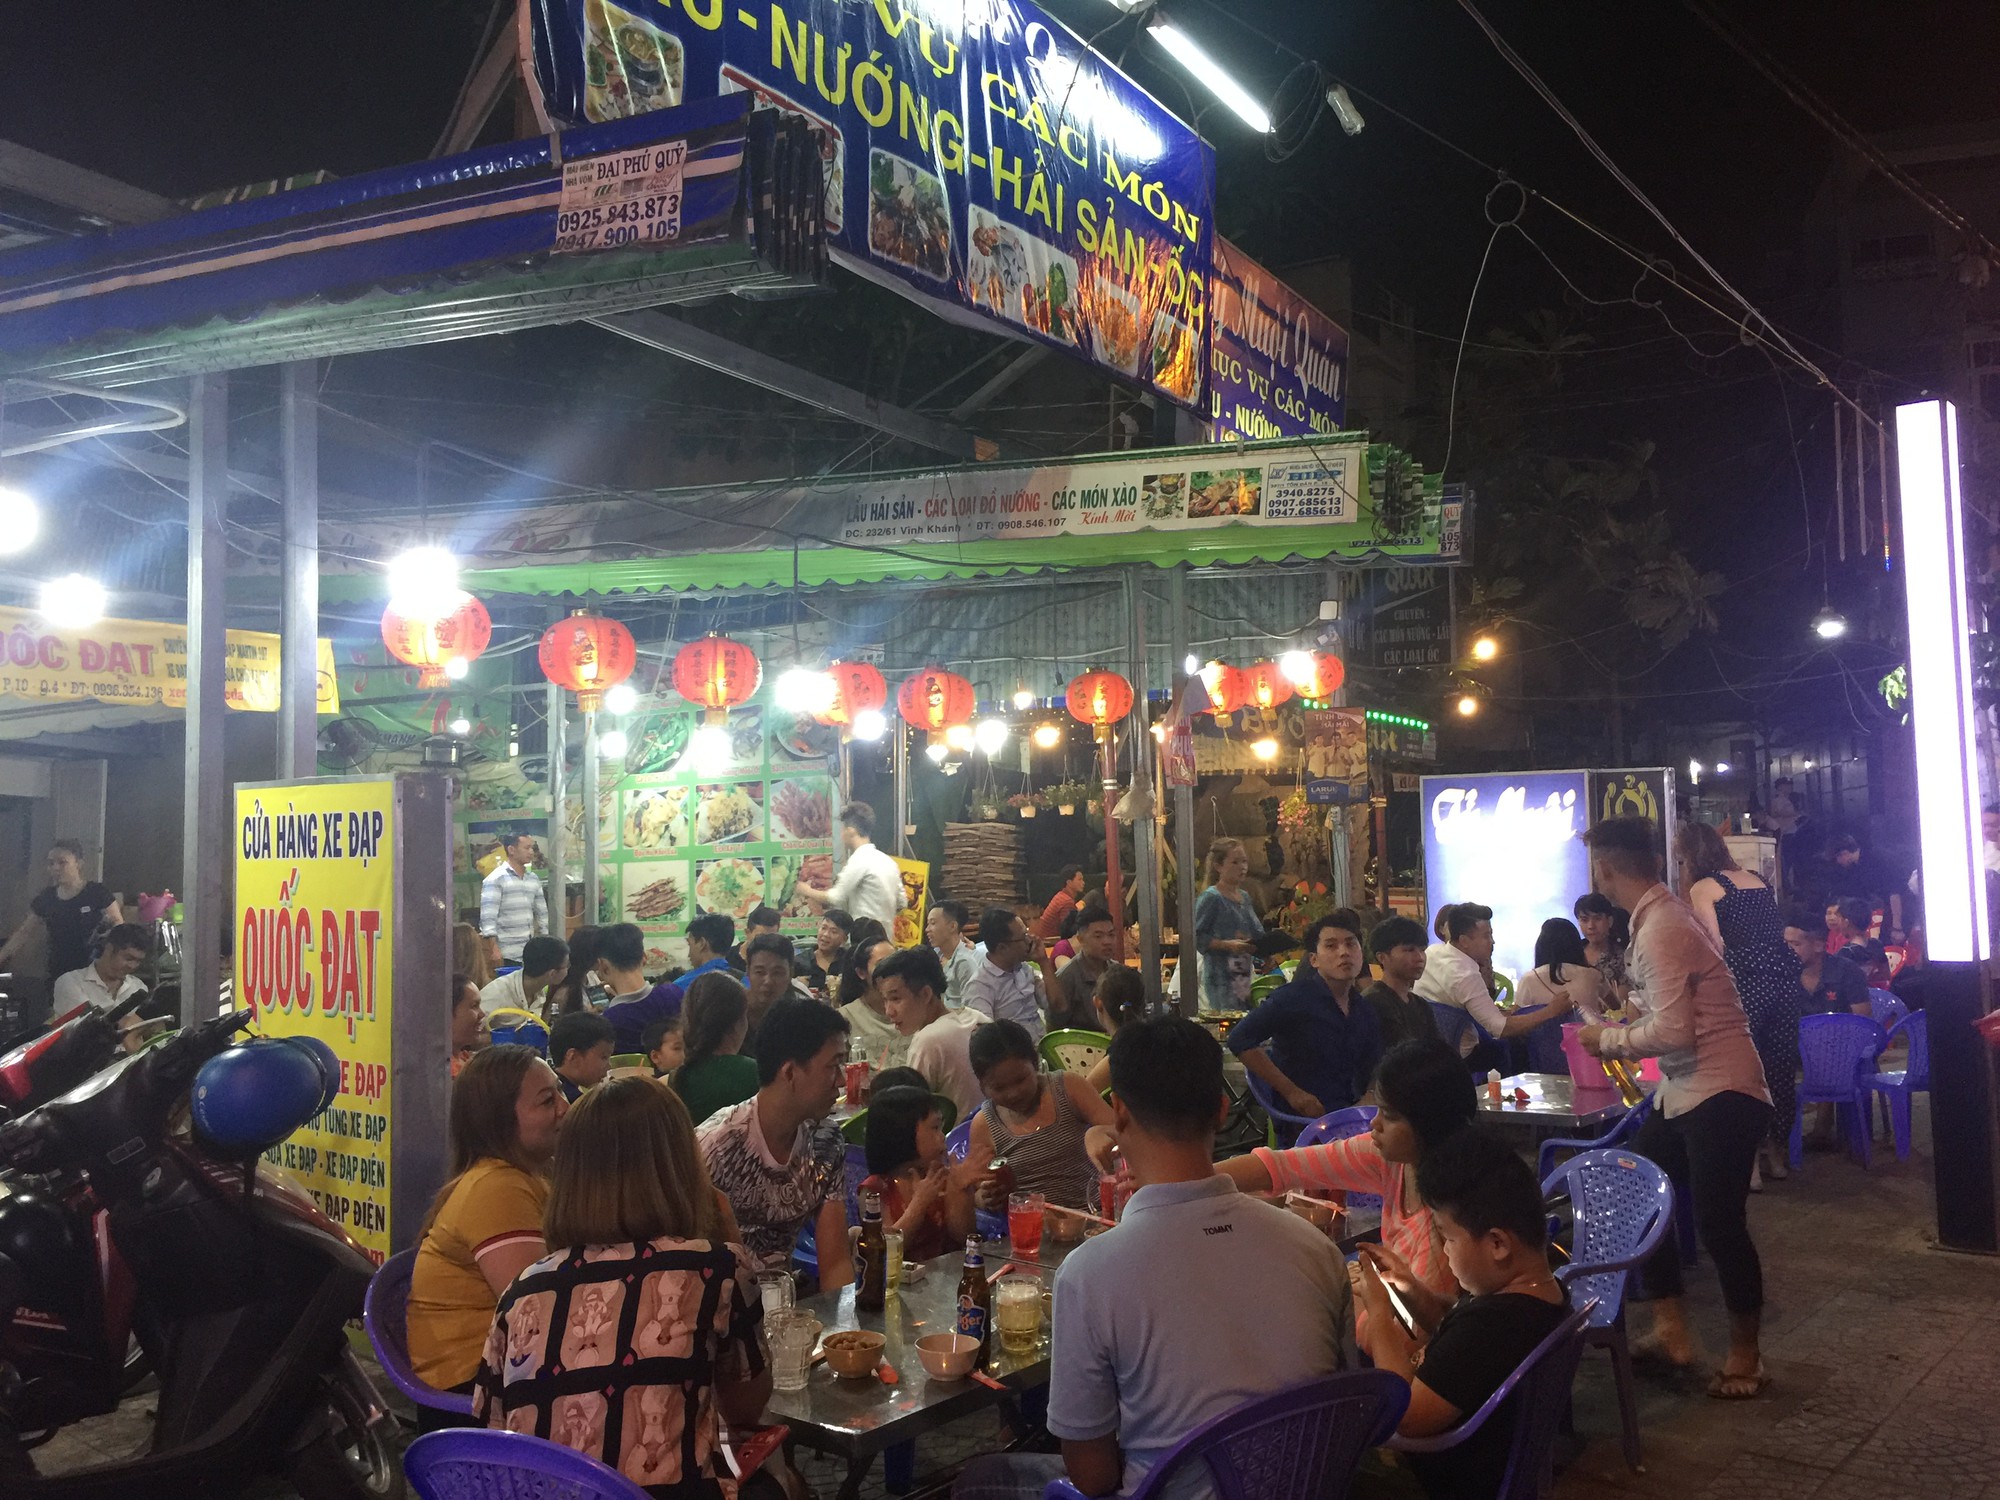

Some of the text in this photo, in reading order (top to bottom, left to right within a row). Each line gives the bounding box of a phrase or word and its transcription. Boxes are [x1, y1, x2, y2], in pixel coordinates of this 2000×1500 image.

[597, 159, 620, 182] ĐẠI
[622, 149, 651, 175] PHÚ
[654, 143, 684, 174] QUÝ
[558, 194, 679, 234] 0925.843.873
[1103, 152, 1200, 243] MÓN
[555, 218, 678, 250] 0947.900.105
[1212, 348, 1242, 385] ỤC
[1274, 388, 1306, 423] CÁC
[870, 495, 889, 521] HẢI
[892, 494, 915, 520] SẢN
[925, 492, 948, 518] CÁC
[951, 495, 976, 519] LOẠI
[979, 487, 997, 515] ĐỒ
[1000, 489, 1041, 514] NƯỚNG
[1052, 486, 1077, 511] CÁC
[1080, 483, 1109, 509] MÓN
[1111, 482, 1138, 507] XÀO
[1267, 506, 1341, 518] 0947.685613
[1268, 497, 1341, 508] 0907.685613
[1276, 487, 1335, 498] 3940.8275
[846, 529, 863, 538] ĐC:
[866, 526, 897, 537] 232/61
[927, 523, 961, 534] Khánh
[977, 521, 994, 531] ĐT:
[998, 517, 1067, 530] 0908.546.107
[79, 638, 156, 682] ĐẠT
[242, 799, 383, 868] CỬA HÀNG XE ĐẠP
[242, 867, 382, 1037] QUỐC ĐẠT
[339, 1060, 387, 1105] E ĐẠP
[350, 1111, 362, 1139] XE
[365, 1113, 387, 1147] ĐẠP
[285, 1143, 296, 1170] XE
[298, 1146, 317, 1178] ĐẠP
[326, 1150, 337, 1179] XE
[339, 1153, 358, 1186] ĐẠP
[360, 1152, 386, 1192] ĐIỆN
[353, 1195, 386, 1236] ĐIỆN
[1202, 1223, 1234, 1236] TOMMY
[957, 1311, 982, 1330] iger
